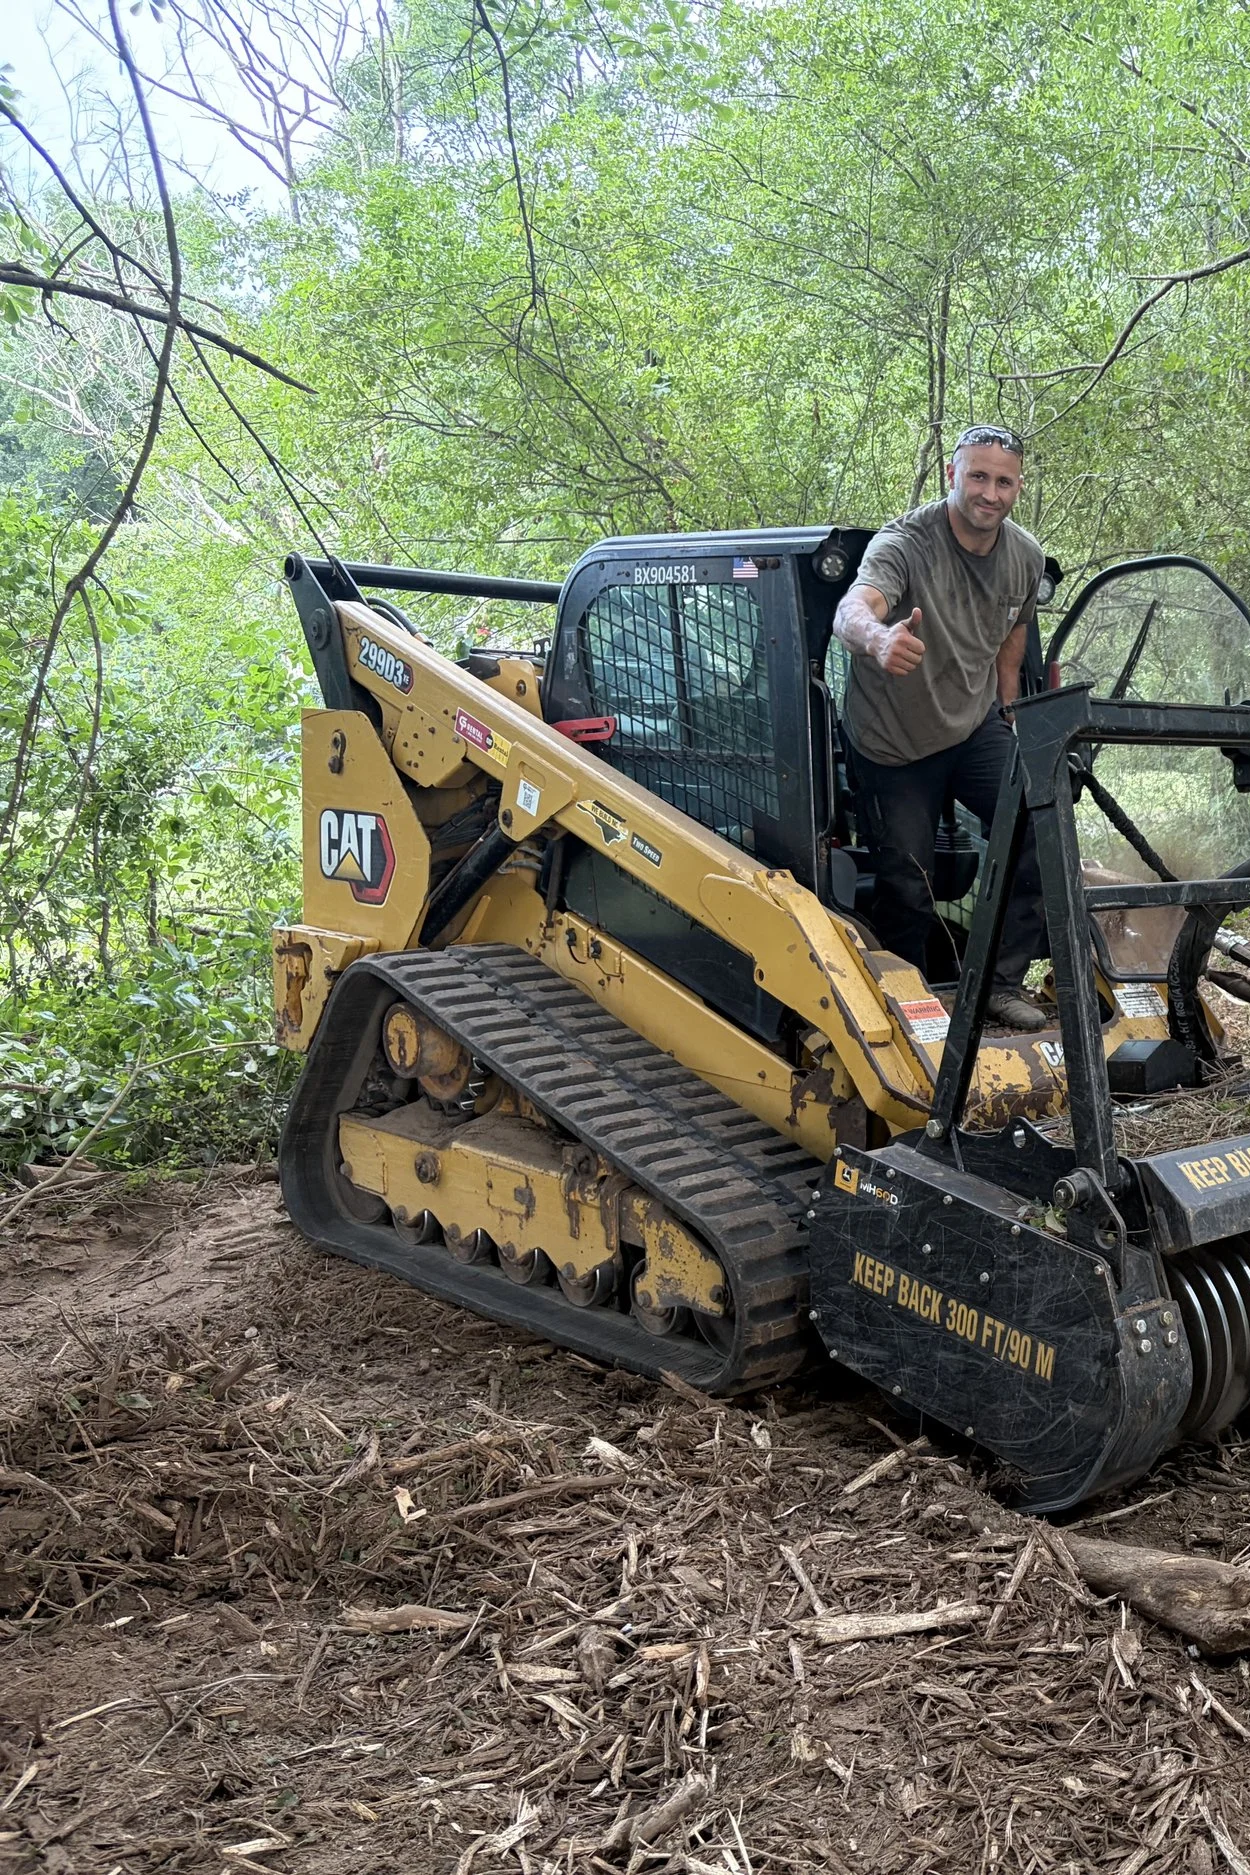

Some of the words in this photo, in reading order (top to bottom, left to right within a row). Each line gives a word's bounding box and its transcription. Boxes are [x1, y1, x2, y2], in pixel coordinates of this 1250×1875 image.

[634, 565, 697, 585] BX904581
[359, 636, 404, 688] 299D3
[466, 723, 483, 740] RENTAL
[592, 804, 600, 814] WE
[320, 810, 376, 882] CAT
[910, 1005, 941, 1014] WARNING
[1178, 1155, 1232, 1194] KEEP
[860, 1178, 899, 1206] MH60D
[853, 1251, 895, 1298] KEEP
[897, 1272, 944, 1325] BACK
[945, 1298, 979, 1343] 300
[981, 1314, 1033, 1370] FT/90
[1034, 1341, 1056, 1381] M
